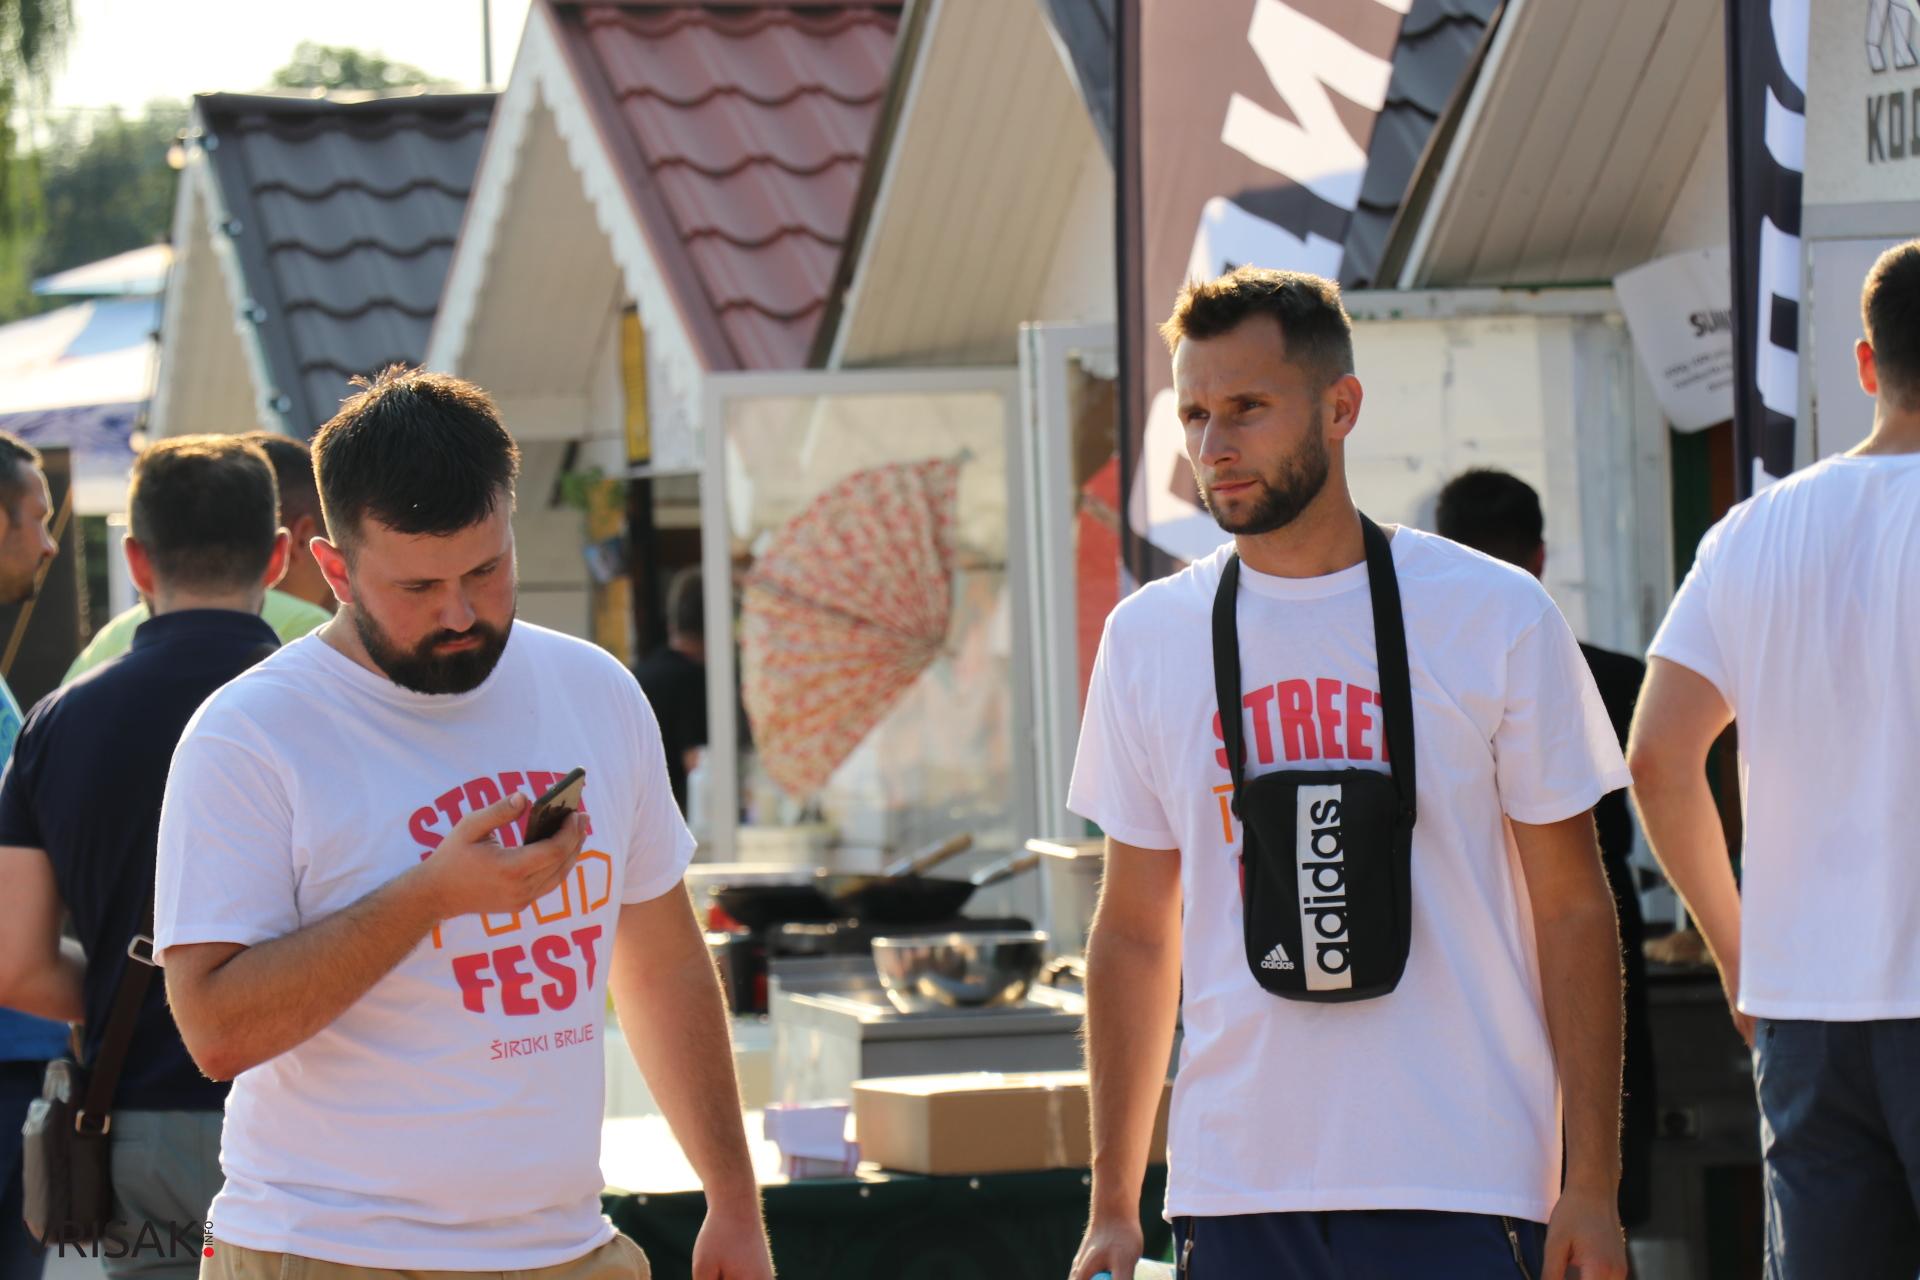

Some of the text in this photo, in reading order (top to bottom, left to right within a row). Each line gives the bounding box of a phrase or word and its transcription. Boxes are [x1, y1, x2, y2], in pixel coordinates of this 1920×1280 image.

[1302, 799, 1351, 975] adidas
[452, 924, 602, 1017] FEST
[1261, 960, 1294, 970] adidas
[491, 1035, 549, 1060] ŠIROKI
